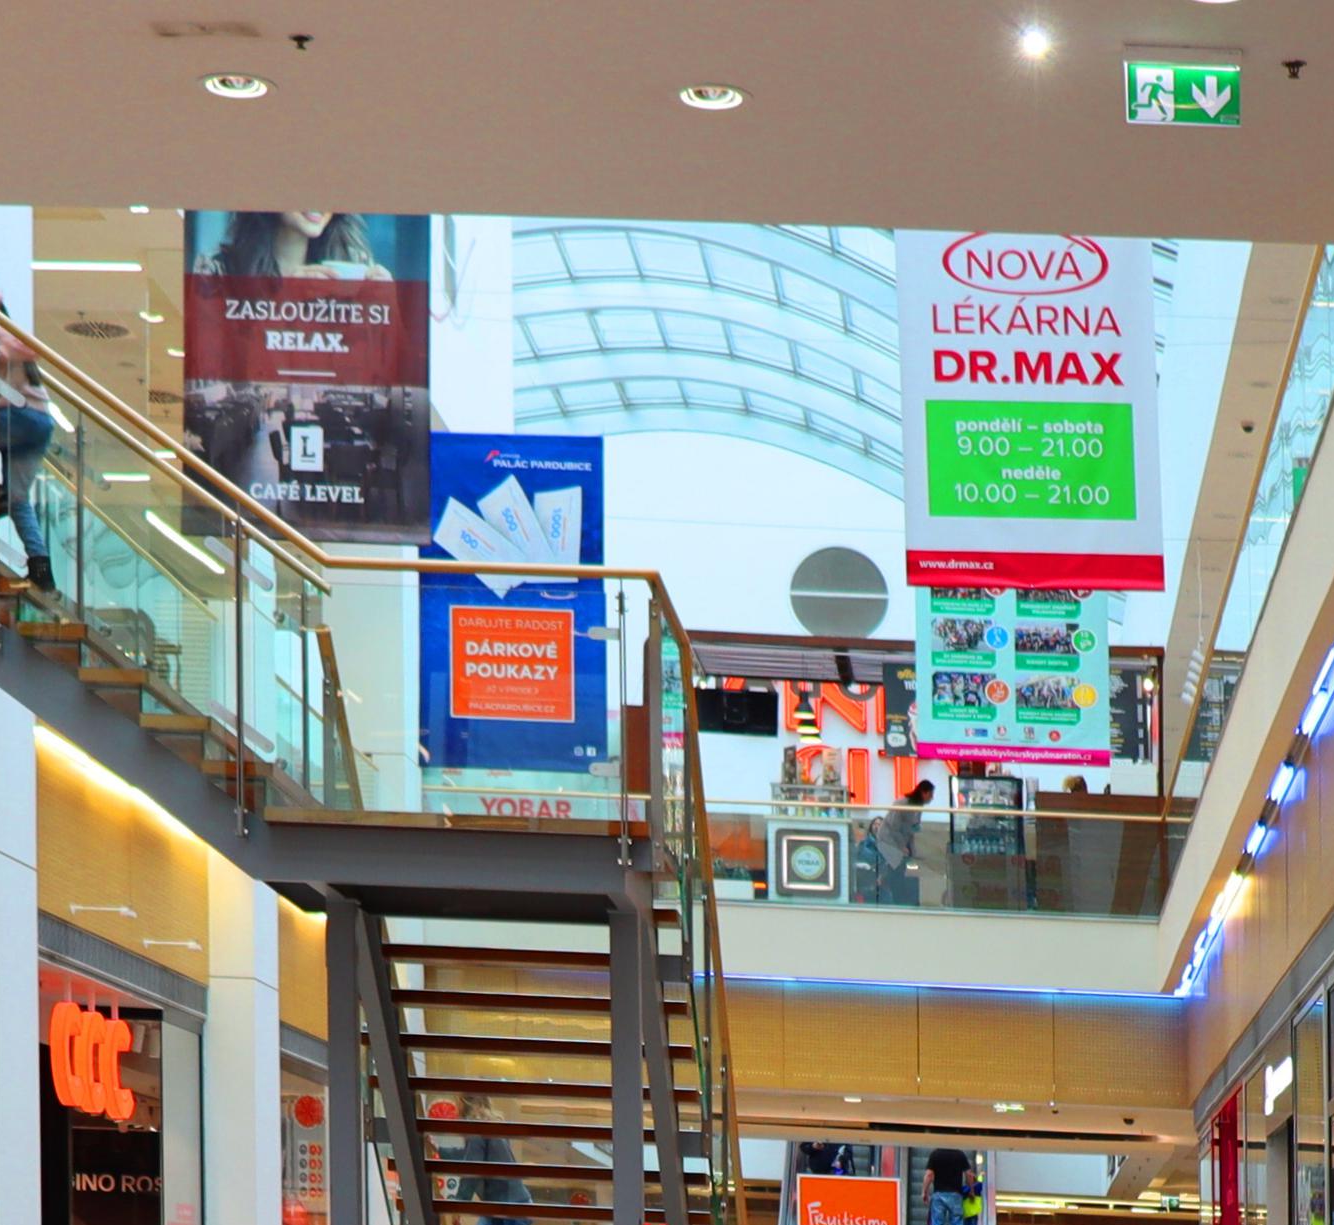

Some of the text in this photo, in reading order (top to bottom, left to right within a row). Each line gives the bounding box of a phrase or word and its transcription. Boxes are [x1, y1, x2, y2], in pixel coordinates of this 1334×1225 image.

[966, 243, 1083, 281] NOVÁ
[225, 297, 390, 325] ZASLOUŽÍTE SI
[931, 296, 1122, 337] LÉKÁRNA
[266, 331, 349, 353] RELAX.
[933, 350, 1124, 386] DR.MAX
[955, 419, 1022, 436] pondělí
[1043, 420, 1104, 435] sobota
[957, 436, 1010, 456] 9.00
[1041, 438, 1103, 458] 21.00
[1001, 465, 1062, 480] neděle
[250, 480, 364, 504] CAFÉ LEVEL
[954, 483, 1016, 504] 10.00
[1048, 485, 1109, 505] 21.00
[460, 530, 479, 549] 100
[919, 558, 994, 570] www.drmax.cz
[458, 616, 564, 631] DARUJTE RADOST
[465, 638, 558, 659] DÁRKOVÉ
[465, 662, 558, 681] POUKAZY
[479, 796, 572, 819] YOBAR
[72, 1173, 116, 1192] INO
